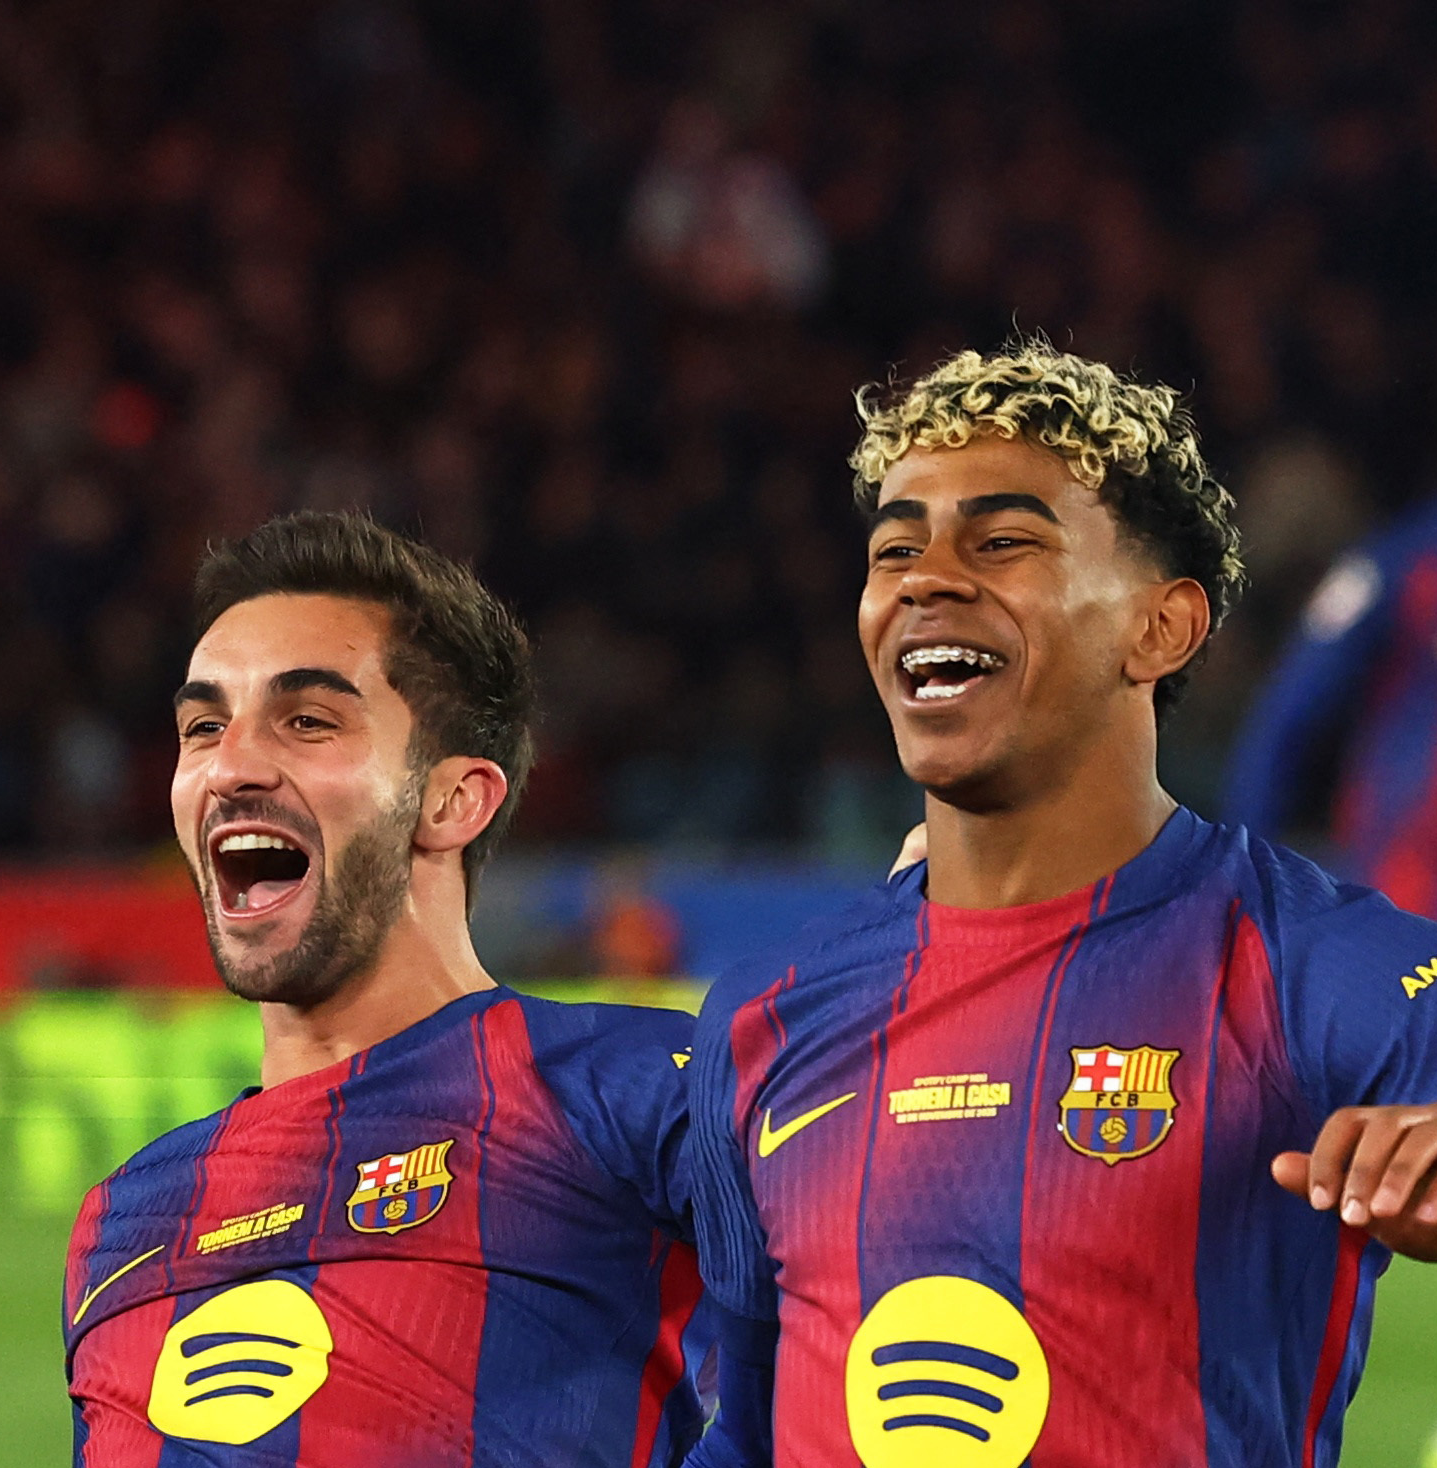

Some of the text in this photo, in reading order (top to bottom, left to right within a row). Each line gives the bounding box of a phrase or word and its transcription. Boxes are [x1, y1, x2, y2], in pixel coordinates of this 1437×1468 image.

[952, 1085, 966, 1108] A
[966, 1082, 1011, 1107] CASA
[196, 1203, 305, 1251] TORNEM A CASA
